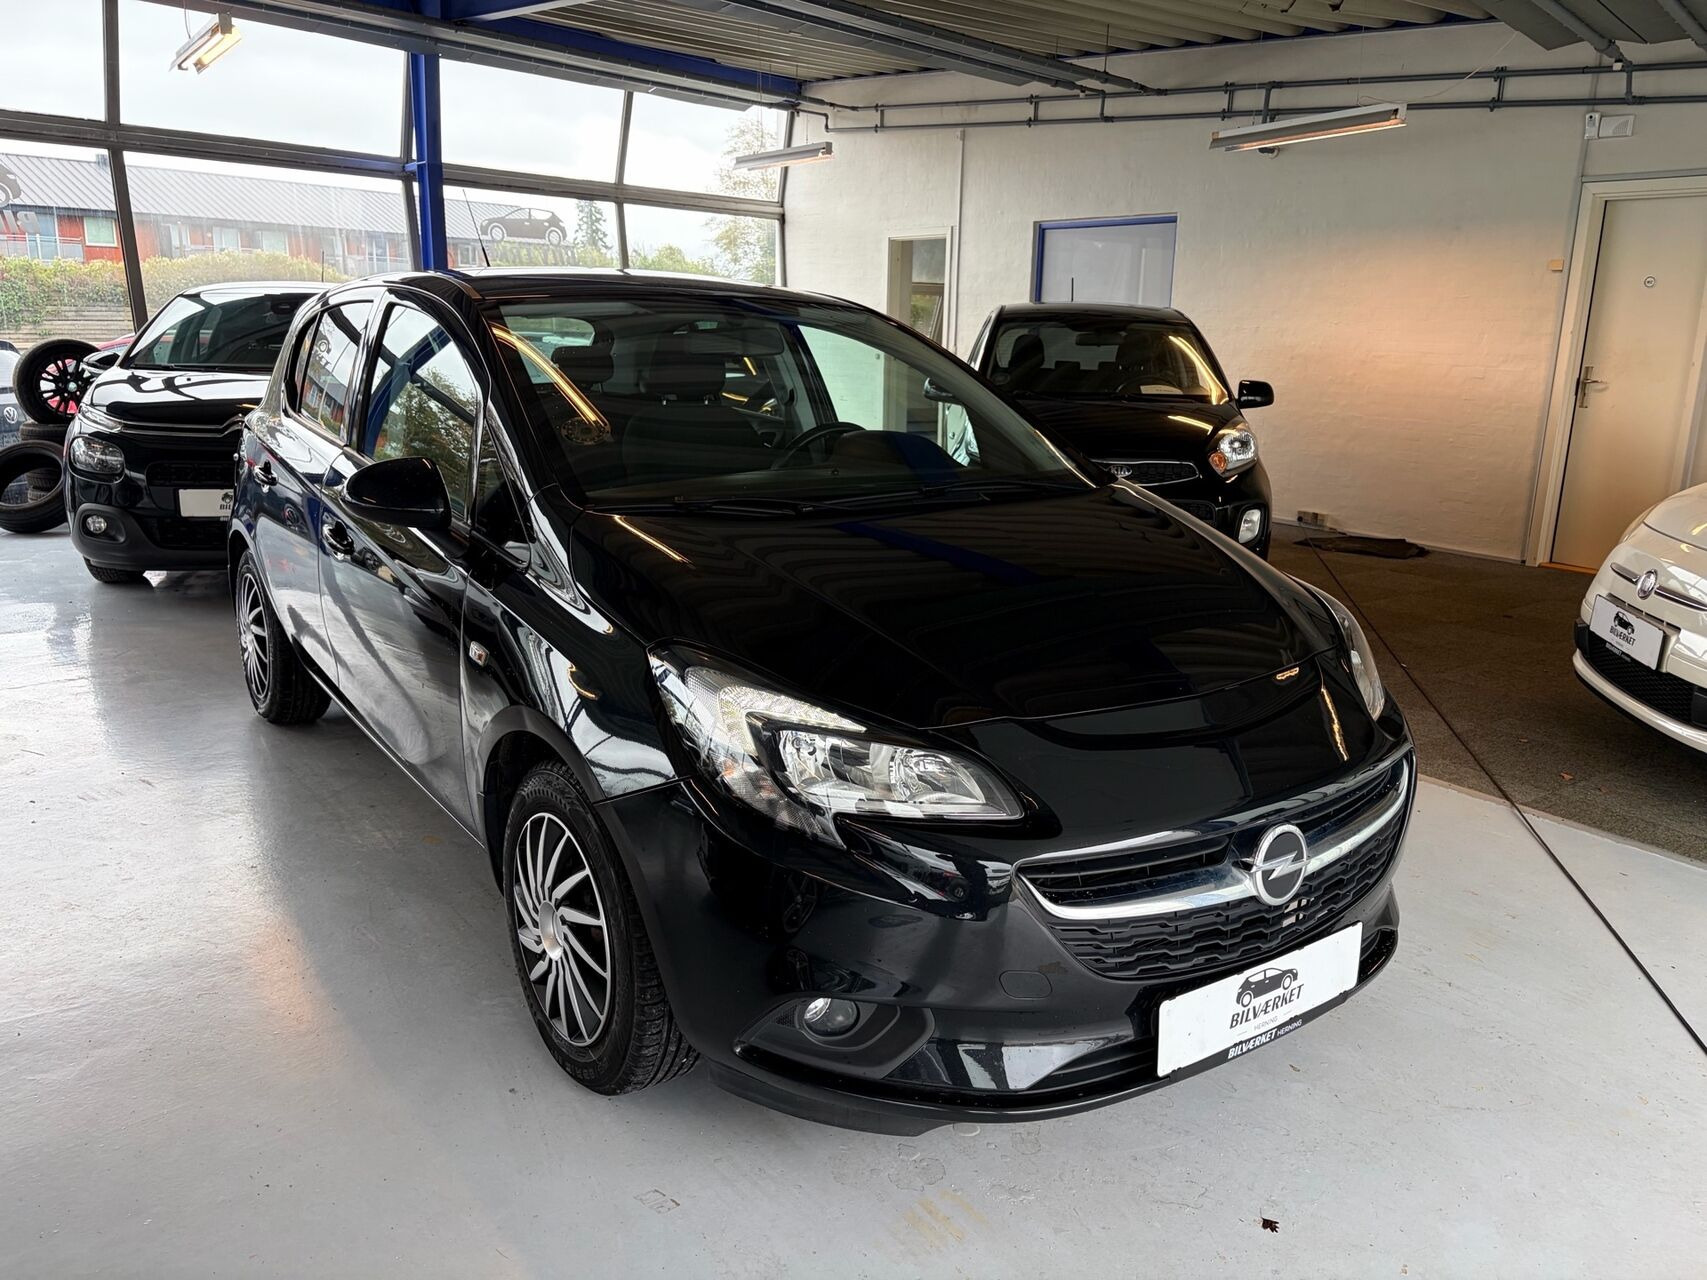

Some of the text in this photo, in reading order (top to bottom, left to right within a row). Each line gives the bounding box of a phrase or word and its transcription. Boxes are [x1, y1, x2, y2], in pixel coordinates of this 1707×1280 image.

[1111, 466, 1128, 474] KIA
[1230, 984, 1304, 1029] BILVÆRKET
[1254, 1017, 1278, 1030] HERNING
[1228, 1019, 1302, 1059] BILVÆRKET HERNING
